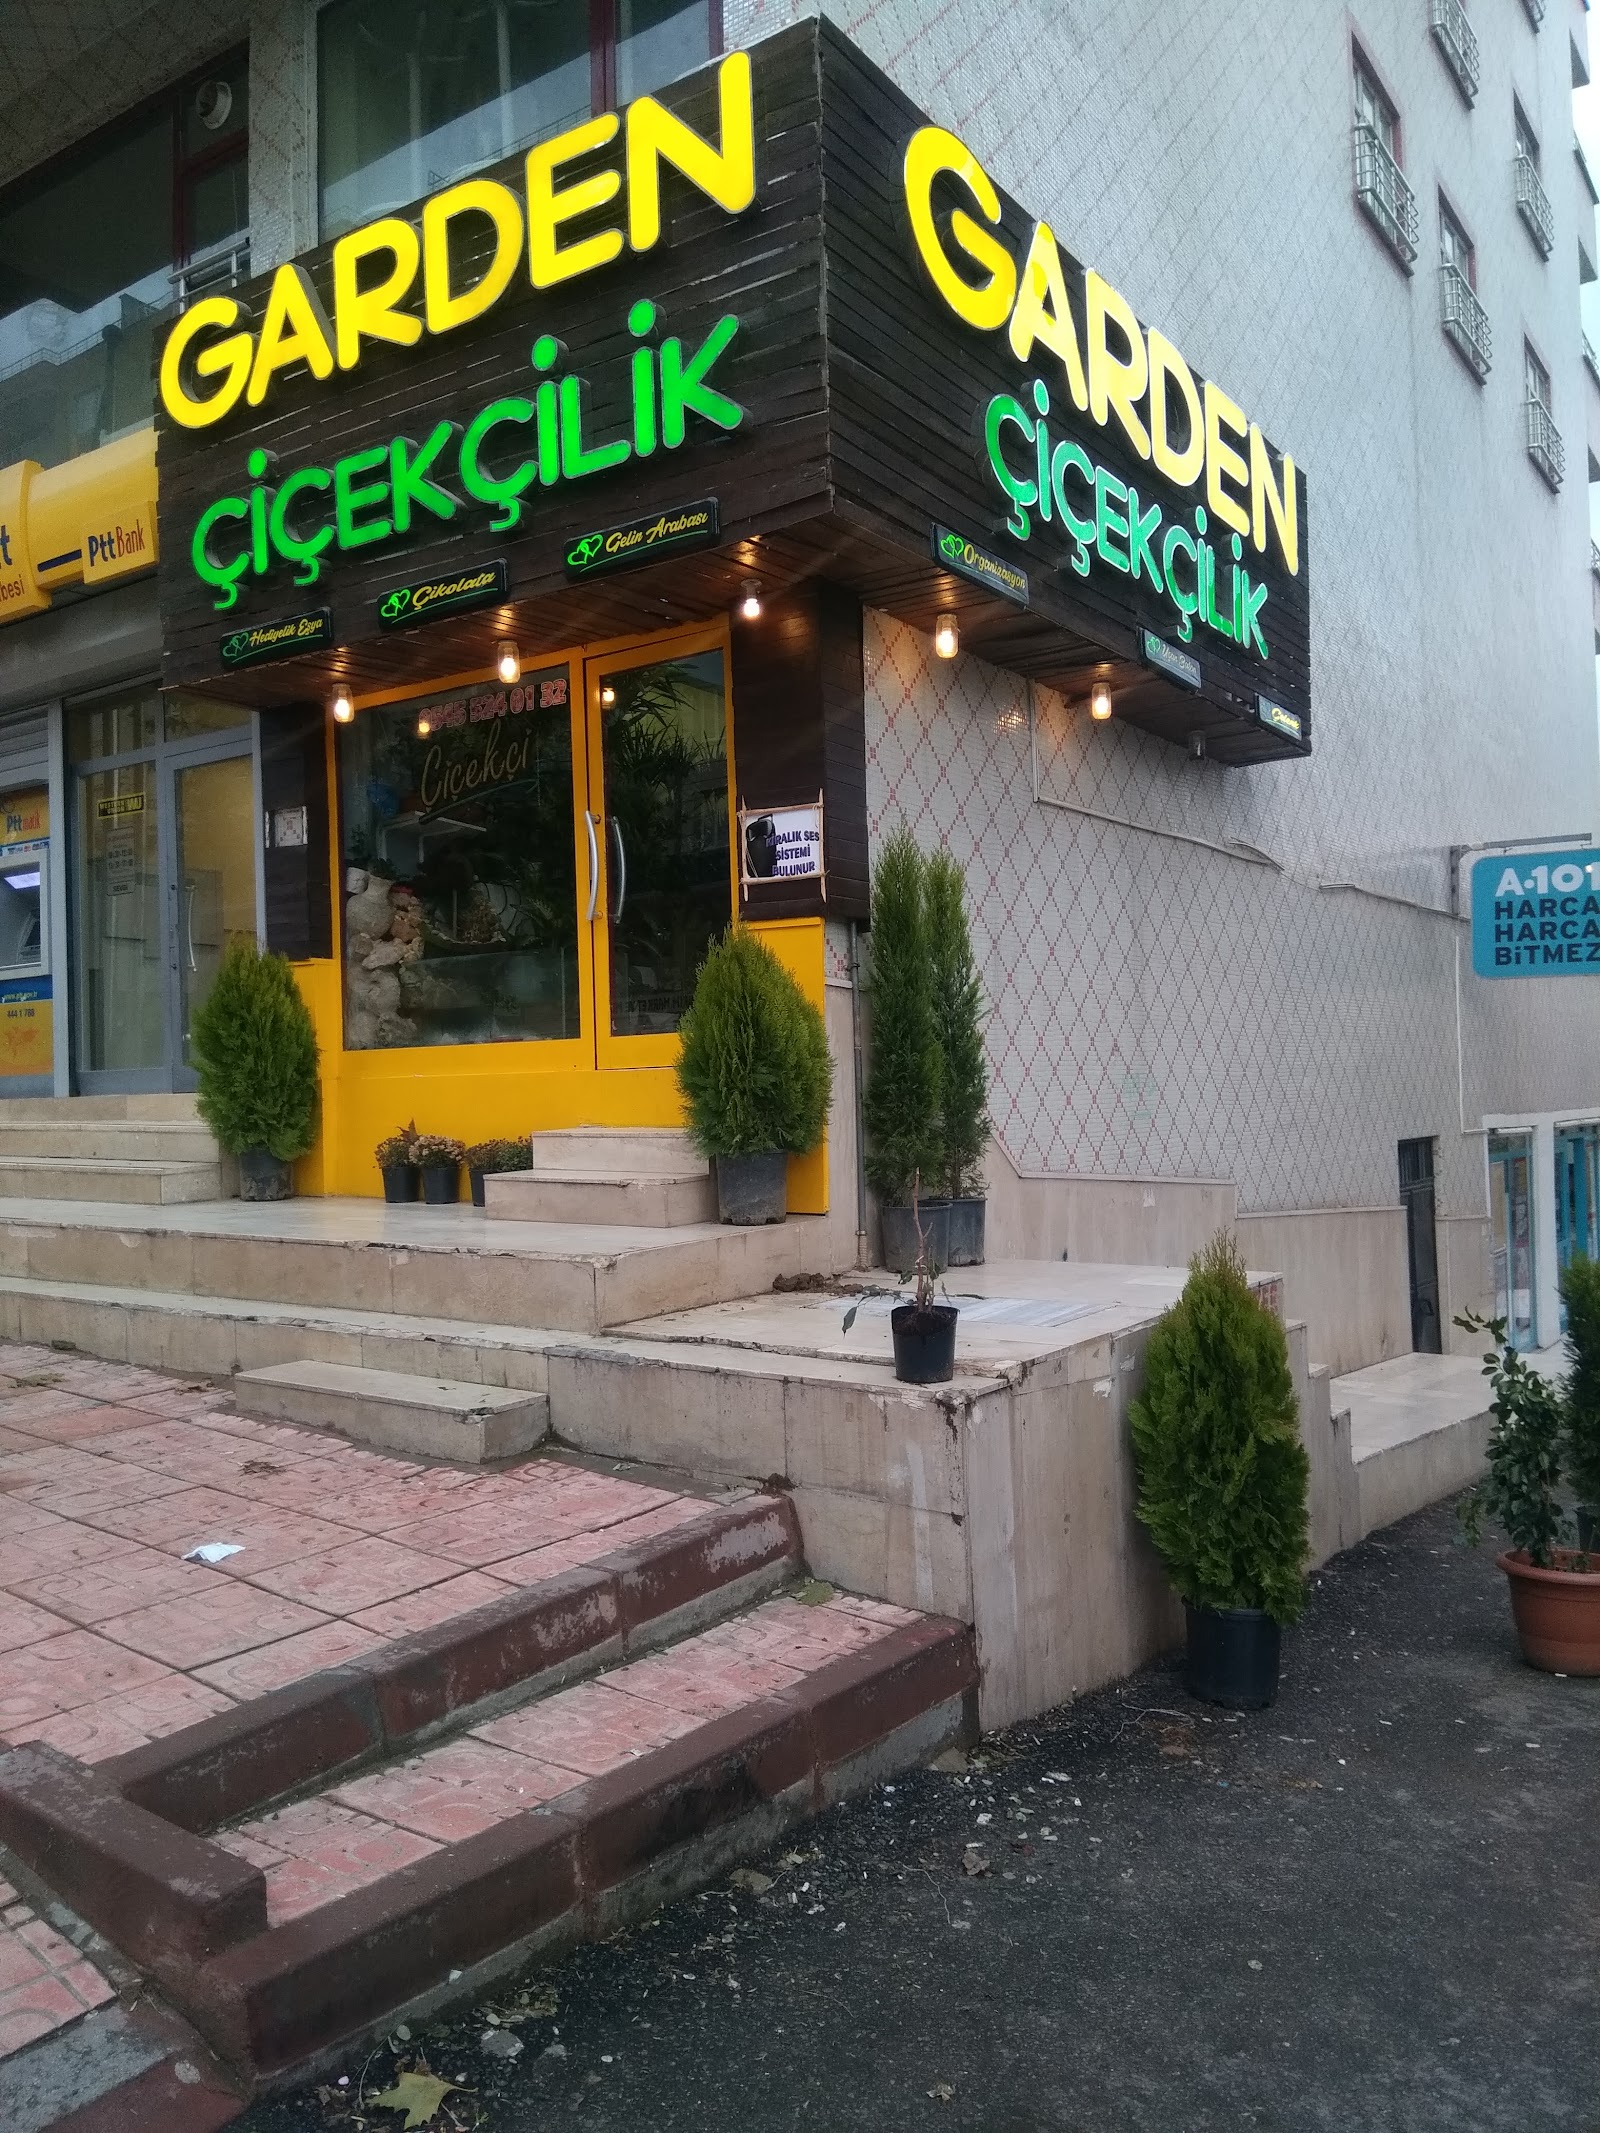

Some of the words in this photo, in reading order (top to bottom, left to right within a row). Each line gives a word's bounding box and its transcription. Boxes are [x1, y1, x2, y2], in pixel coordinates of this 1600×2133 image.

[158, 50, 755, 428] GARDEN
[903, 124, 1299, 577] GARDEN
[191, 299, 743, 609] ÇİÇEKÇİLİK
[605, 530, 643, 553] Gelin
[645, 512, 709, 544] Arabası
[984, 379, 1270, 661] ÇİÇEKÇİLİK
[963, 543, 1026, 589] Organizasyon
[411, 570, 497, 610] Çikolata
[249, 623, 296, 647] Hediyelik
[297, 618, 323, 637] Eşya
[469, 691, 507, 723] 524
[509, 685, 535, 714] 01
[539, 678, 568, 708] 32
[775, 844, 811, 861] SİSTEMİ
[803, 829, 820, 842] SES
[772, 861, 816, 877] BULUNUR
[1494, 895, 1600, 920] HARCA
[1494, 918, 1600, 943] HARCA
